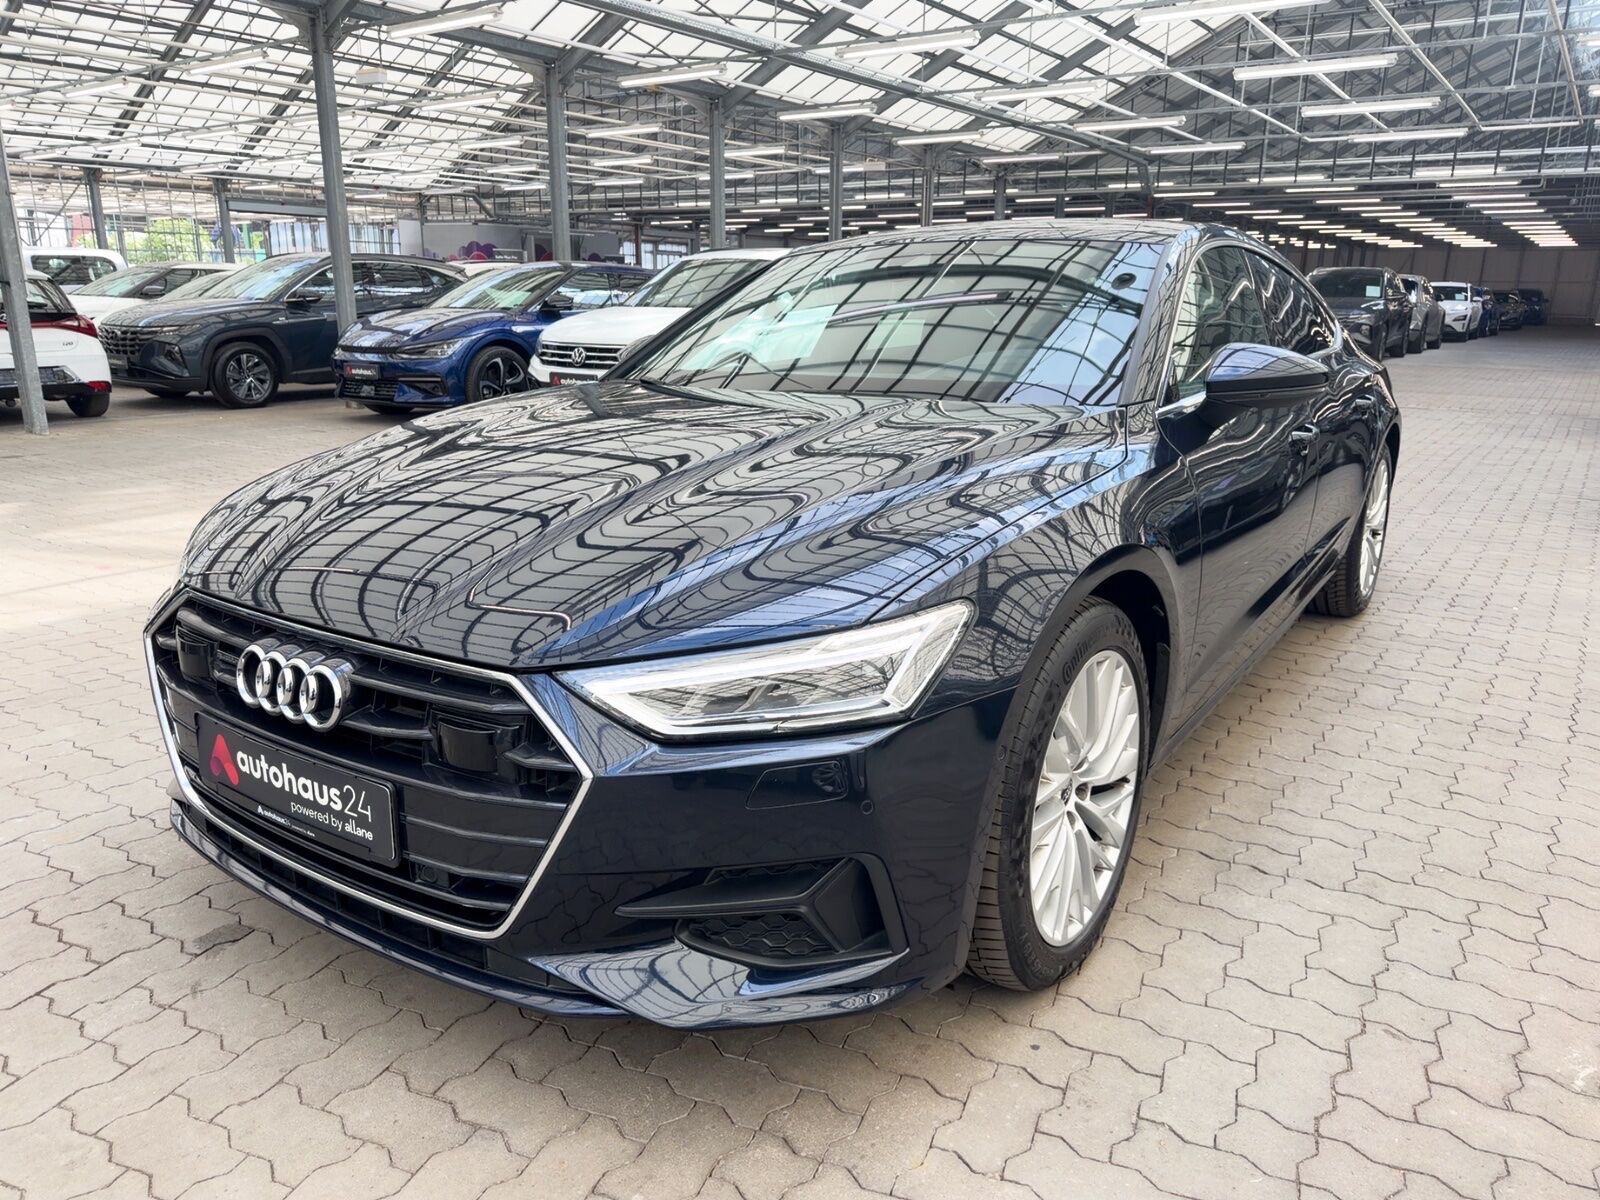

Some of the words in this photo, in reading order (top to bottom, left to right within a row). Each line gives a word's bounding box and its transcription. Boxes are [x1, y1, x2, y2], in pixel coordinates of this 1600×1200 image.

[236, 750, 372, 823] autohaus24
[290, 801, 329, 824] powered
[330, 814, 343, 832] by
[344, 821, 374, 841] allane
